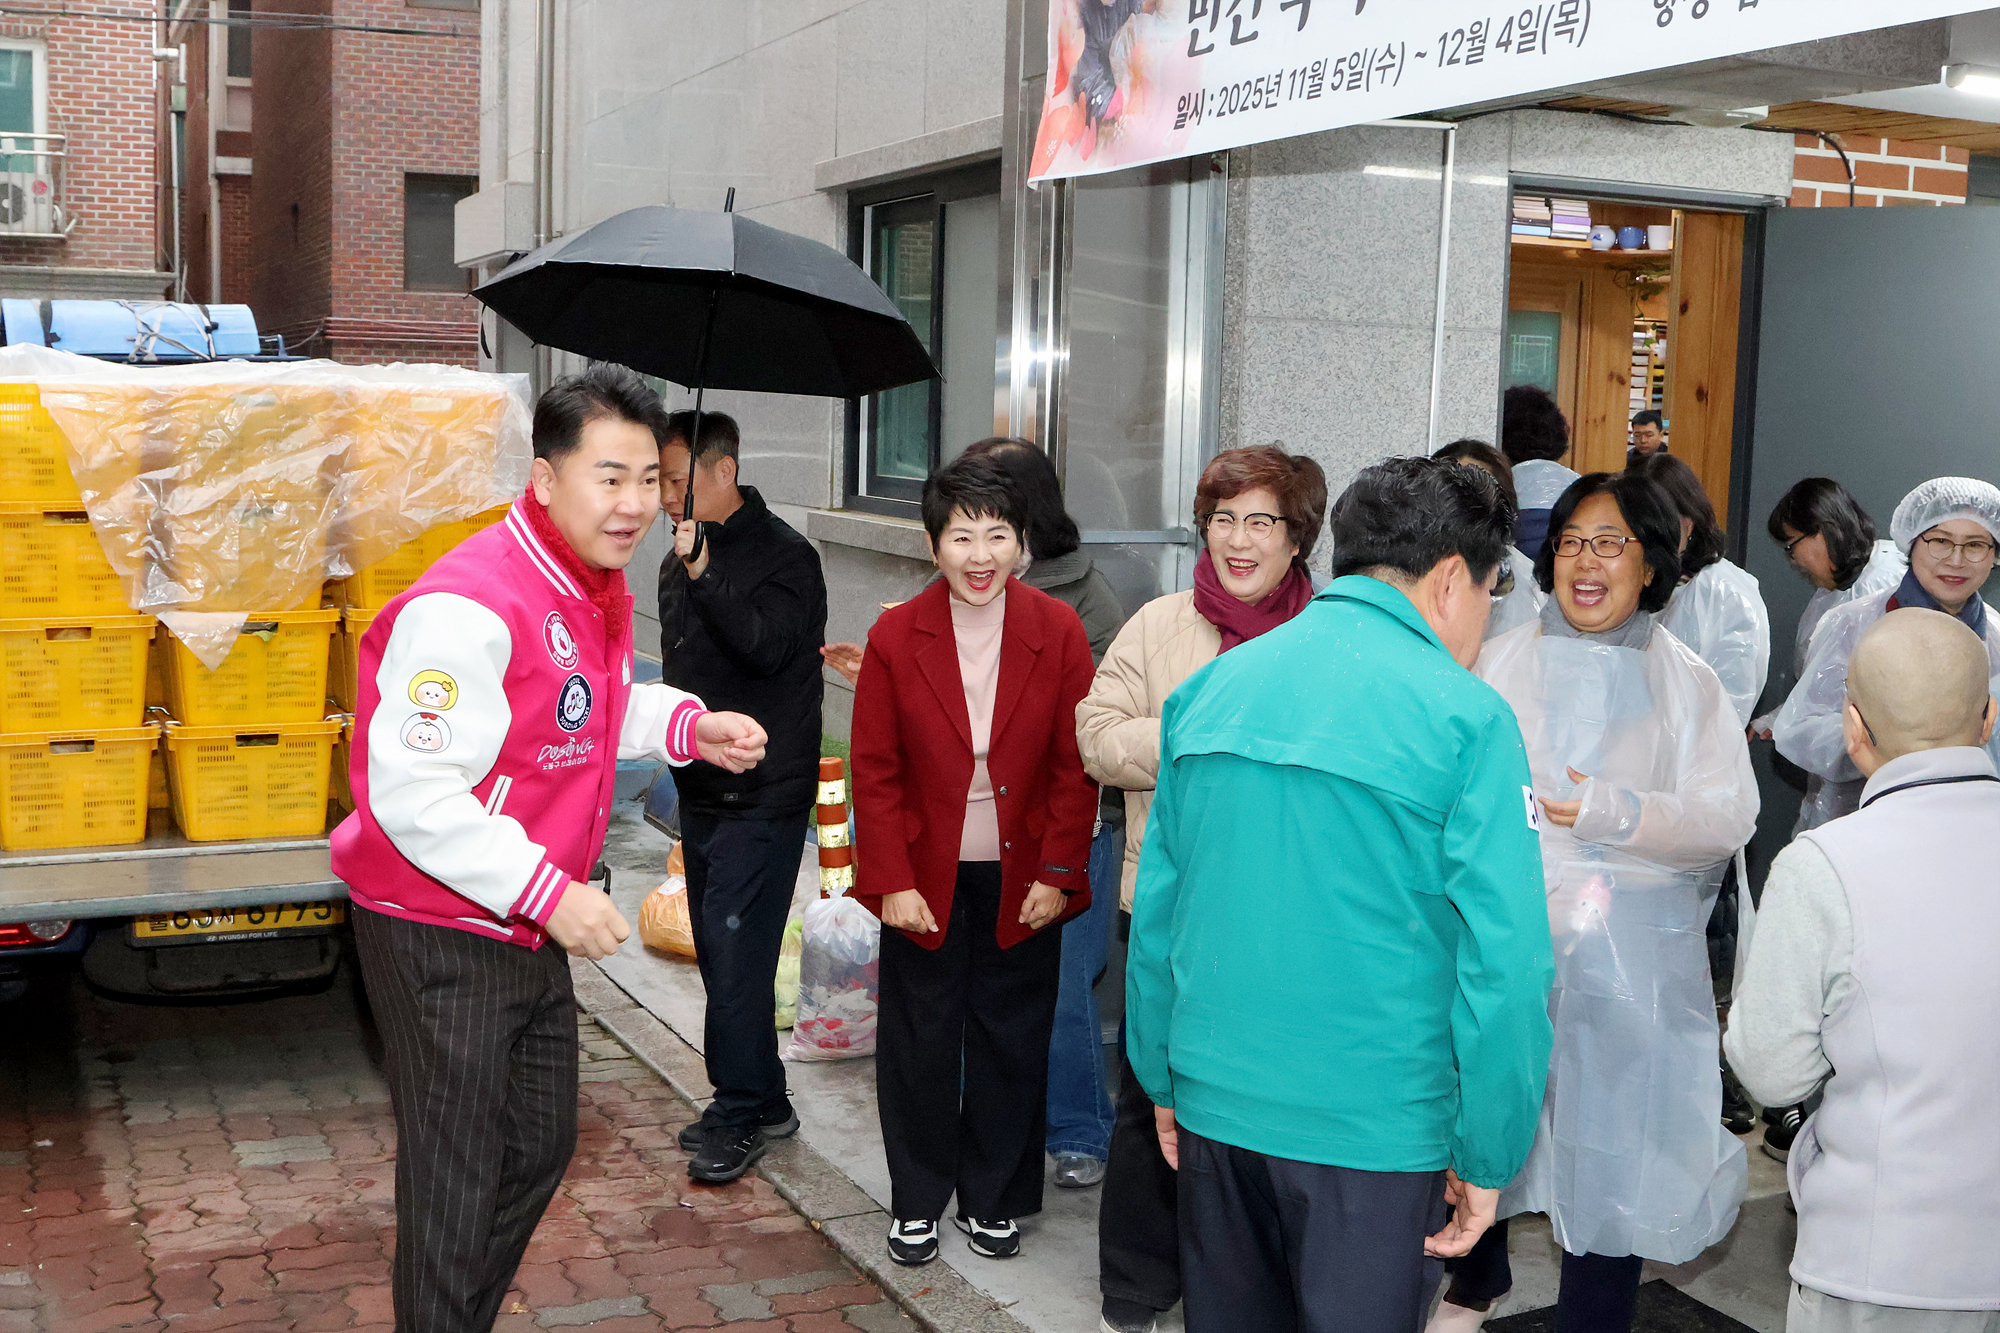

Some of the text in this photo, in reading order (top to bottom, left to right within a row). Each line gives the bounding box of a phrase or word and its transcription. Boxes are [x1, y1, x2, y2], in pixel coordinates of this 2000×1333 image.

[1288, 58, 1327, 100] 11월
[1331, 41, 1405, 92] 5일(수)
[1438, 17, 1490, 67] 12월
[1495, 0, 1591, 55] 4일(목)
[218, 932, 247, 941] HYUNDAI
